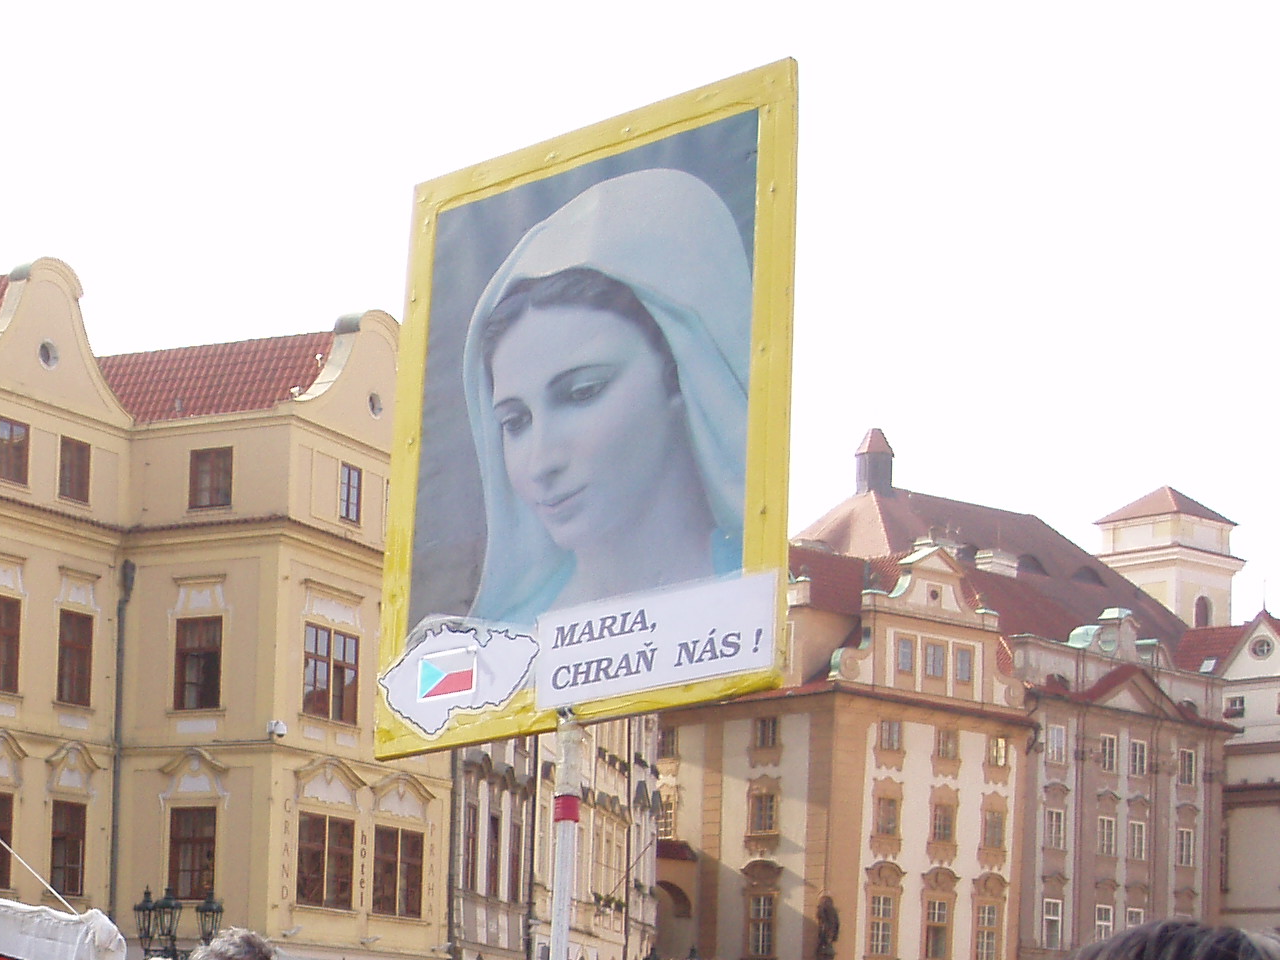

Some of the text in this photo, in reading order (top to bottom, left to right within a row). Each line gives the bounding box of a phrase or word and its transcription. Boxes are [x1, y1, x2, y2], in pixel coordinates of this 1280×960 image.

[551, 608, 657, 650] MARIA,
[551, 642, 658, 691] CHRAŇ
[281, 798, 292, 900] GRAND
